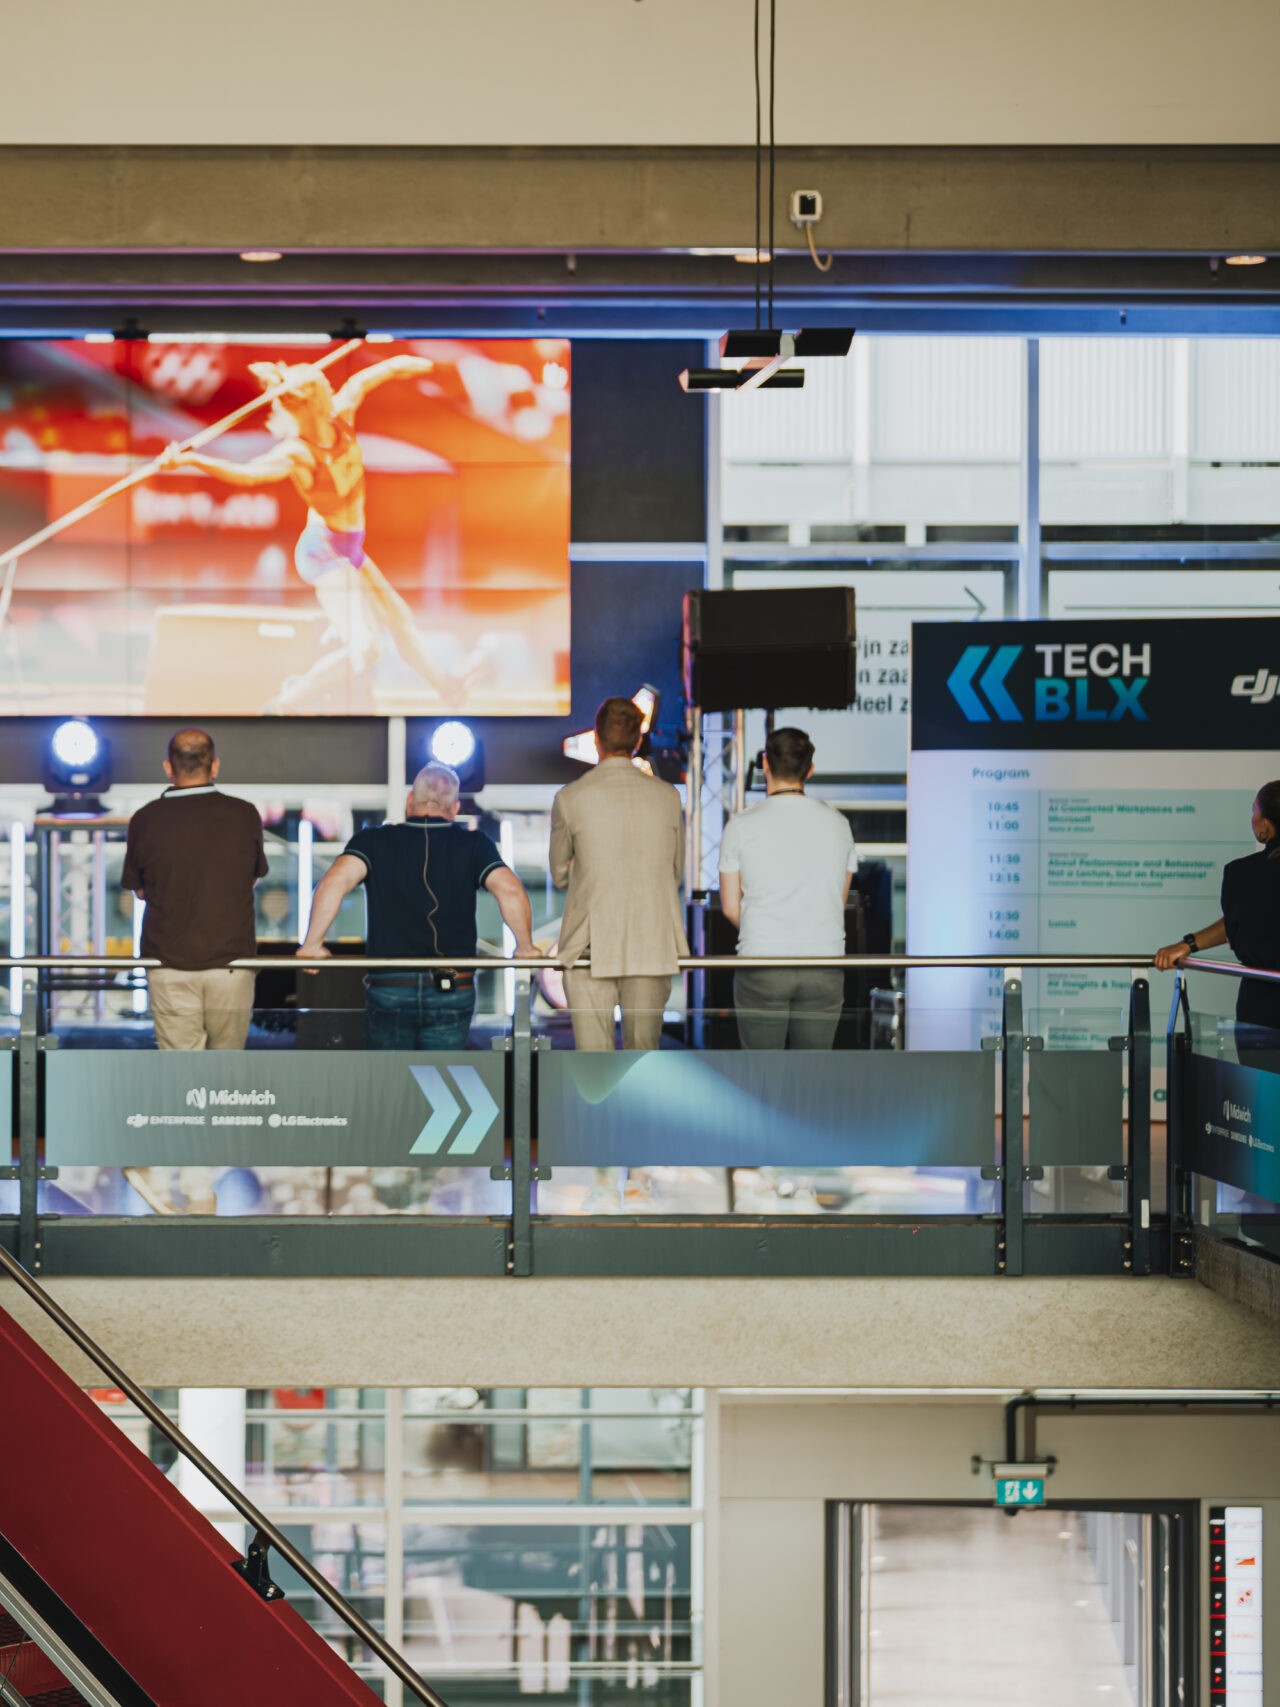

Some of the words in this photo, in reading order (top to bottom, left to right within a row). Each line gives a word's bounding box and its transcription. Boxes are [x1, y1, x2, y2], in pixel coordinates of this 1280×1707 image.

[1034, 643, 1151, 677] TECH
[1034, 677, 1151, 722] BLX
[972, 767, 1030, 780] Program
[988, 801, 1019, 812] 10:45
[988, 821, 1019, 831] 11:00
[989, 854, 1021, 864] 11:30
[989, 873, 1021, 883] 12:15
[988, 910, 1020, 921] 12:30
[988, 930, 1020, 940] 14:00
[209, 1089, 276, 1106] Midwich
[149, 1115, 205, 1125] ENTERPRISE
[211, 1115, 263, 1126] SAMSUNG
